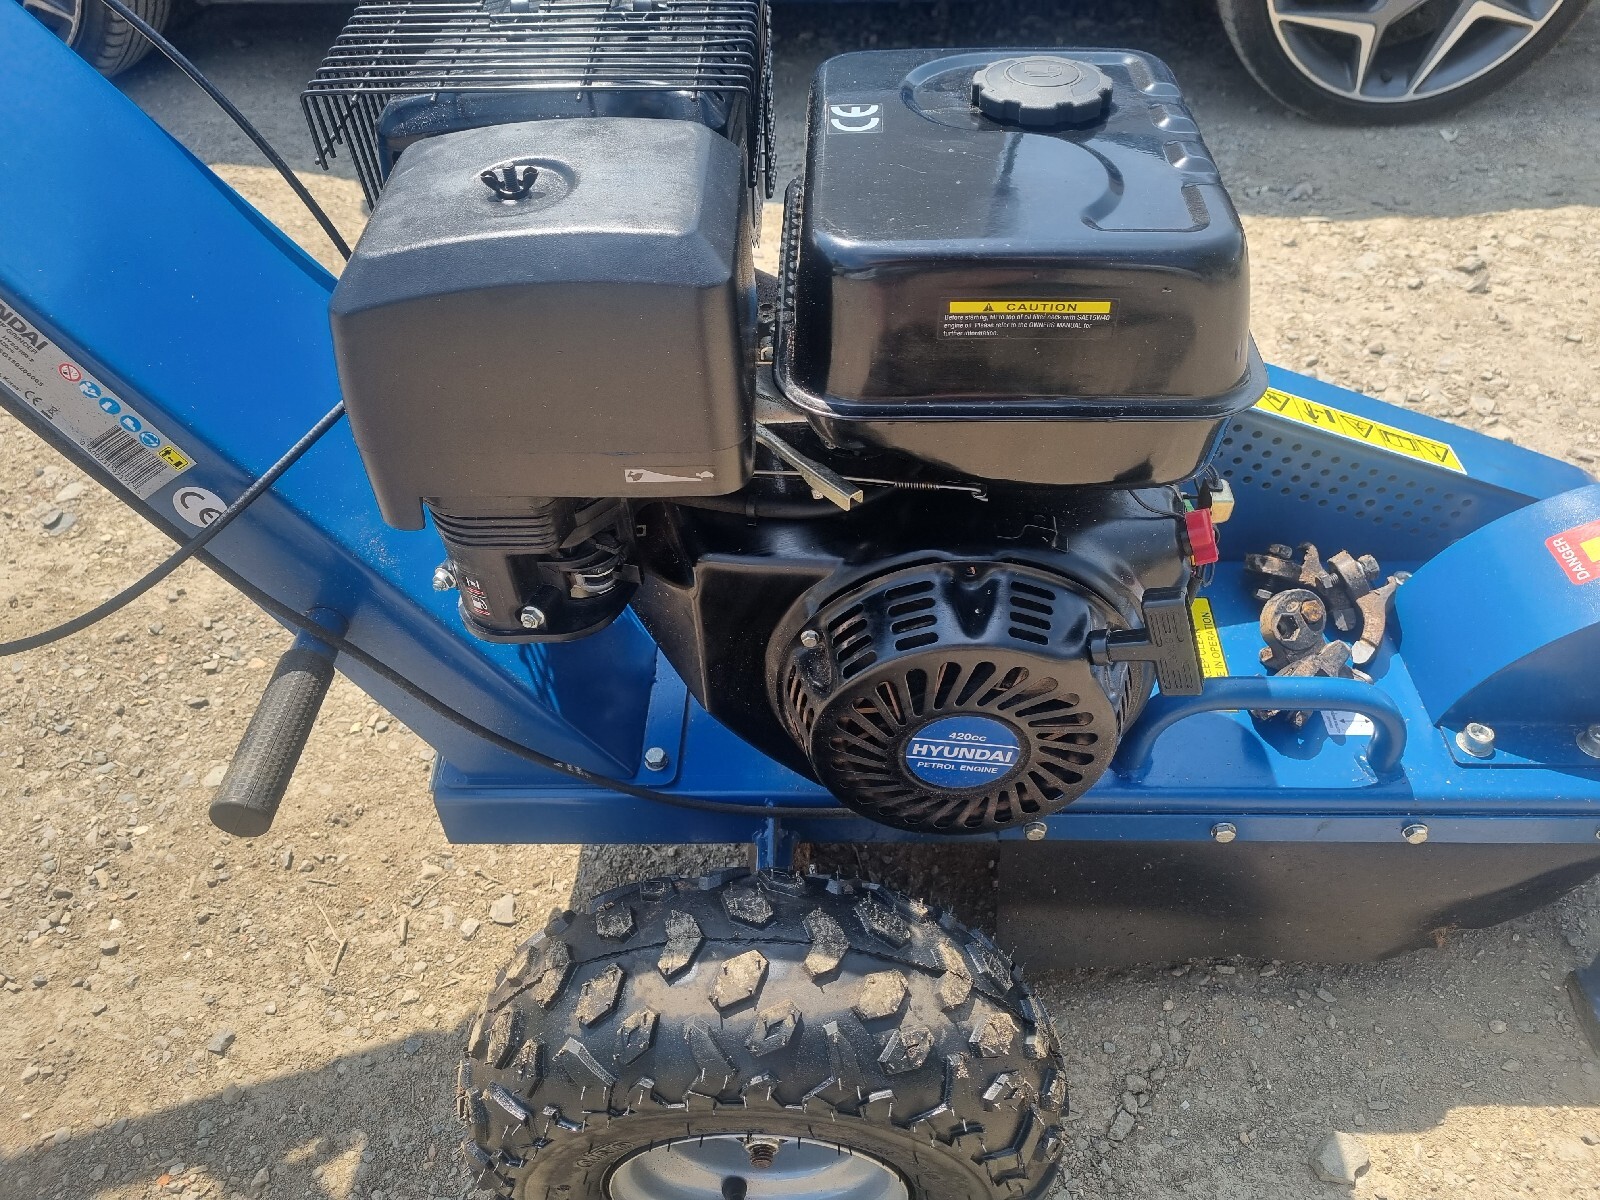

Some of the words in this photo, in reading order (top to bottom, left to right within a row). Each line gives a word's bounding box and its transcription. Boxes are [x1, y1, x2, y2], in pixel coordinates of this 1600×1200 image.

[1006, 303, 1078, 312] CAUTION
[1006, 314, 1016, 322] top
[6, 328, 38, 354] GRINDER
[1552, 536, 1591, 581] DANGER
[1201, 612, 1222, 659] OPERATION
[1214, 660, 1225, 670] IN
[948, 732, 988, 742] 420cc
[912, 743, 1013, 763] HYUNDAI
[917, 761, 957, 771] PETROL
[959, 764, 999, 774] ENGINE
